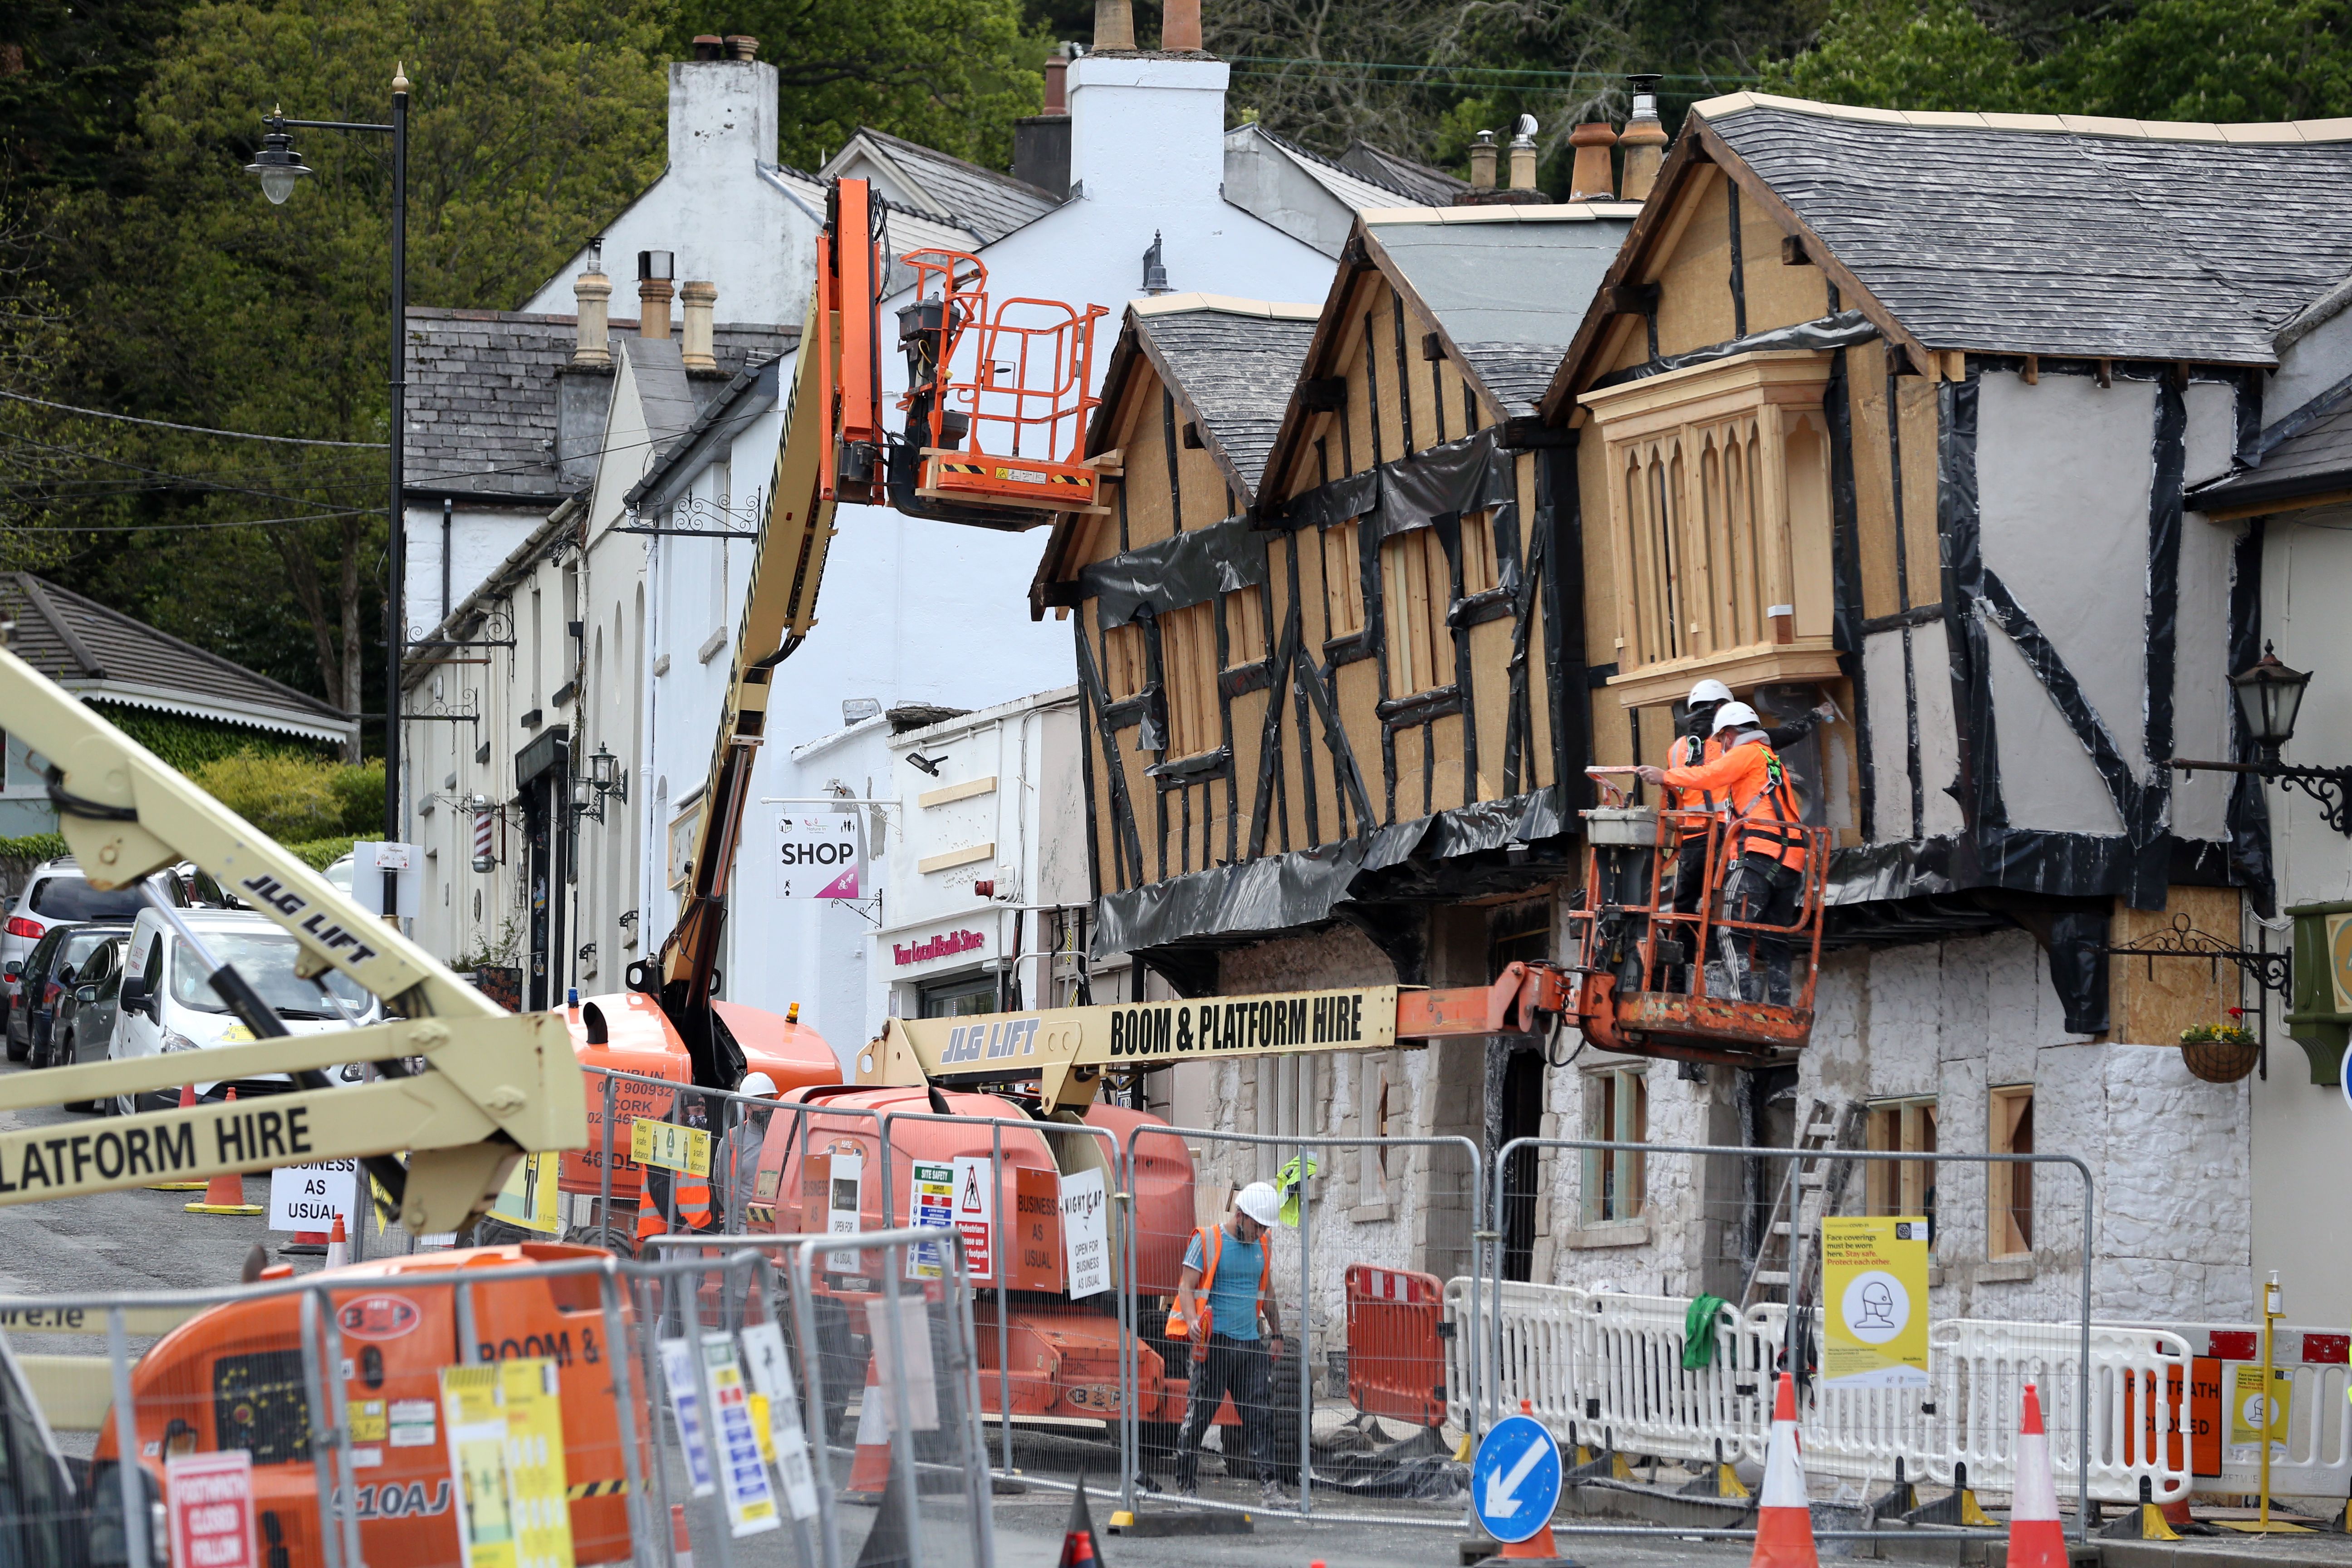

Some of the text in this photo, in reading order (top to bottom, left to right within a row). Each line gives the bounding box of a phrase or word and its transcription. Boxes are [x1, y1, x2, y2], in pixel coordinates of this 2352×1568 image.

[782, 843, 853, 865] SHOP
[243, 876, 376, 963] JLG LIFT
[893, 929, 984, 965] Your Local Health Store
[1111, 995, 1362, 1056] BOOM & PLATFORM HIRE
[941, 1017, 1041, 1064] JLG LIFT
[216, 1107, 312, 1164] HIRE
[637, 1122, 646, 1133] Keep
[669, 1132, 672, 1146] 2
[695, 1134, 704, 1146] Keep
[840, 1139, 853, 1149] HIRE
[634, 1149, 648, 1160] distance
[691, 1161, 706, 1172] distance
[921, 1169, 949, 1181] SITE SAFETY
[304, 1179, 326, 1195] AS
[803, 1181, 828, 1197] BUSINESS
[288, 1203, 336, 1220] USUAL
[1018, 1194, 1056, 1216] BUSINESS
[810, 1206, 818, 1222] AS
[834, 1220, 853, 1233] OPEN FOR
[959, 1224, 985, 1234] Pedestrians
[1032, 1224, 1043, 1241] AS
[969, 1248, 988, 1260] footpath
[1075, 1240, 1099, 1257] OPEN FOR
[833, 1253, 852, 1265] AS USUAL
[1025, 1249, 1052, 1269] USUAL
[1076, 1256, 1100, 1274] BUSINESS
[1078, 1276, 1101, 1291] AS USUAL
[583, 1327, 600, 1364] &
[1075, 1389, 1087, 1403] B
